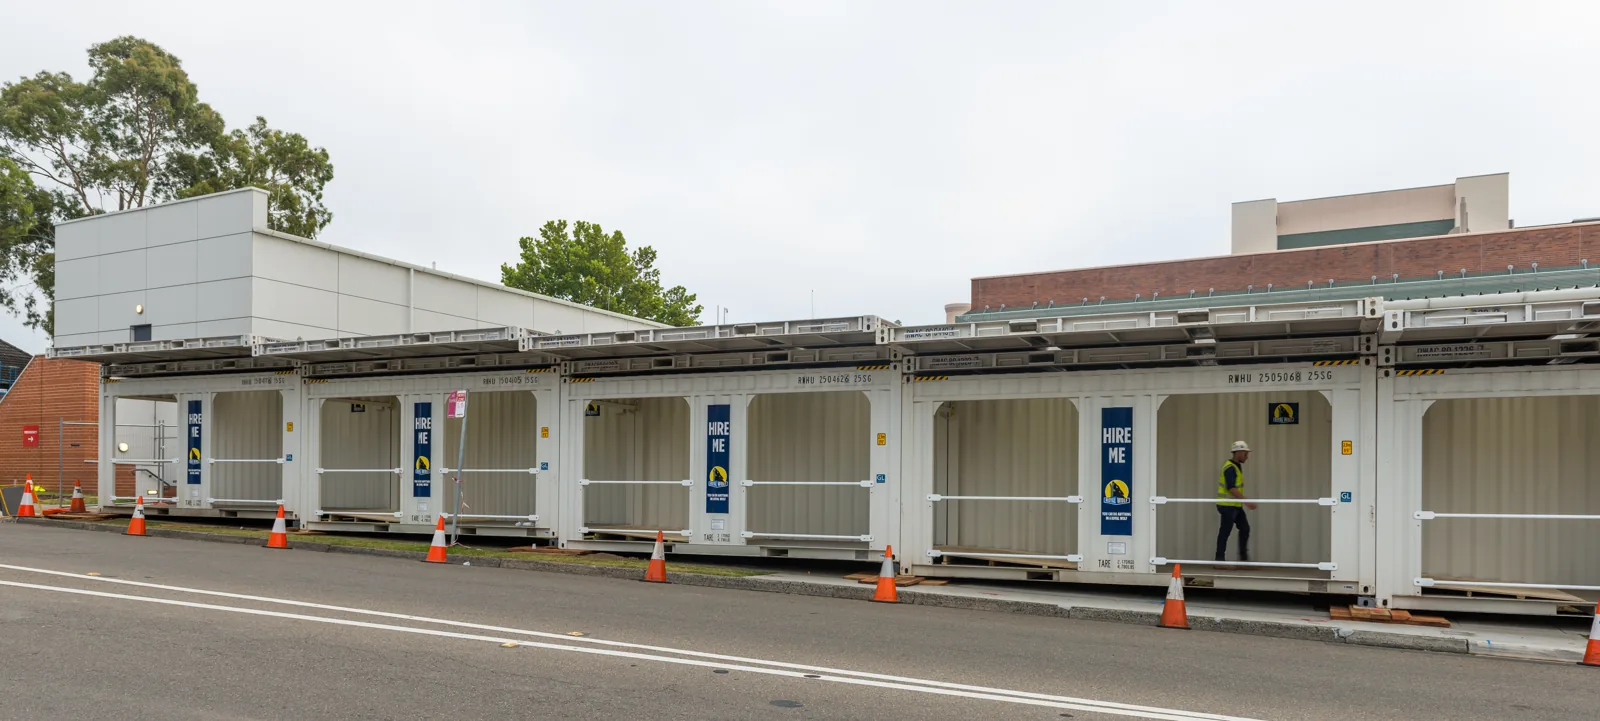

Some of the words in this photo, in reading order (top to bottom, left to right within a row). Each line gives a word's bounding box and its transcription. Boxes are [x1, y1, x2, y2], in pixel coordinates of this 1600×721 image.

[797, 376, 815, 384] RWHU
[854, 374, 872, 383] 25SG
[1228, 374, 1252, 383] RWHU
[1259, 372, 1302, 382] 2505068
[1308, 371, 1332, 381] 25SG
[415, 417, 432, 430] HIRE
[708, 421, 730, 436] HIRE
[1103, 427, 1132, 444] HIRE
[712, 438, 725, 452] ME
[1108, 447, 1126, 463] ME
[1098, 559, 1111, 568] TARE
